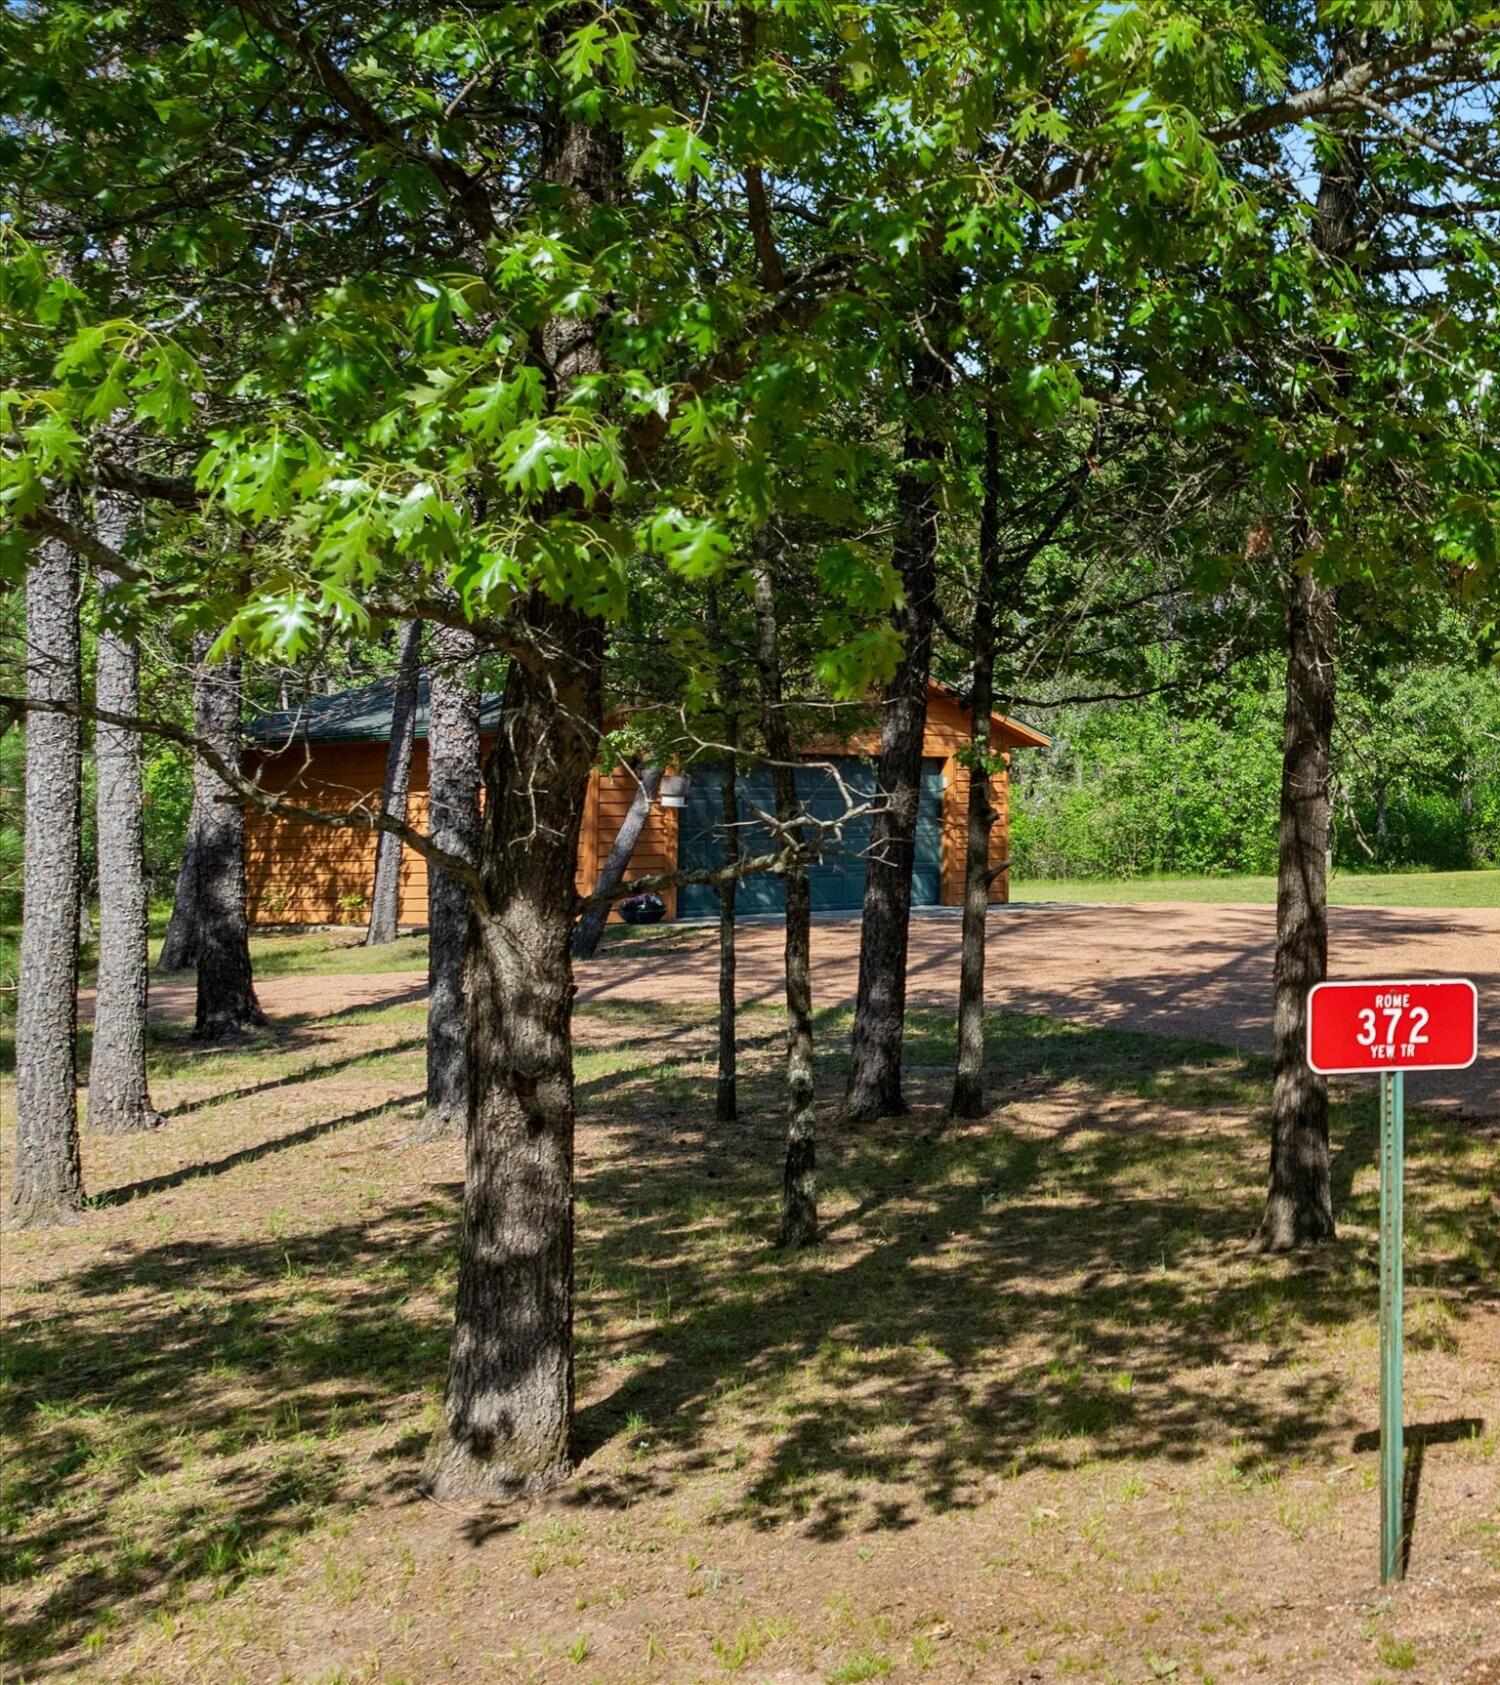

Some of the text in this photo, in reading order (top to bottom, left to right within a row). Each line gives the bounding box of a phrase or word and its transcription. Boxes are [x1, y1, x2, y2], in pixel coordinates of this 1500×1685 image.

[1375, 994, 1410, 1008] ROME
[1356, 1006, 1430, 1046] 372
[1370, 1044, 1416, 1059] YEW TR
